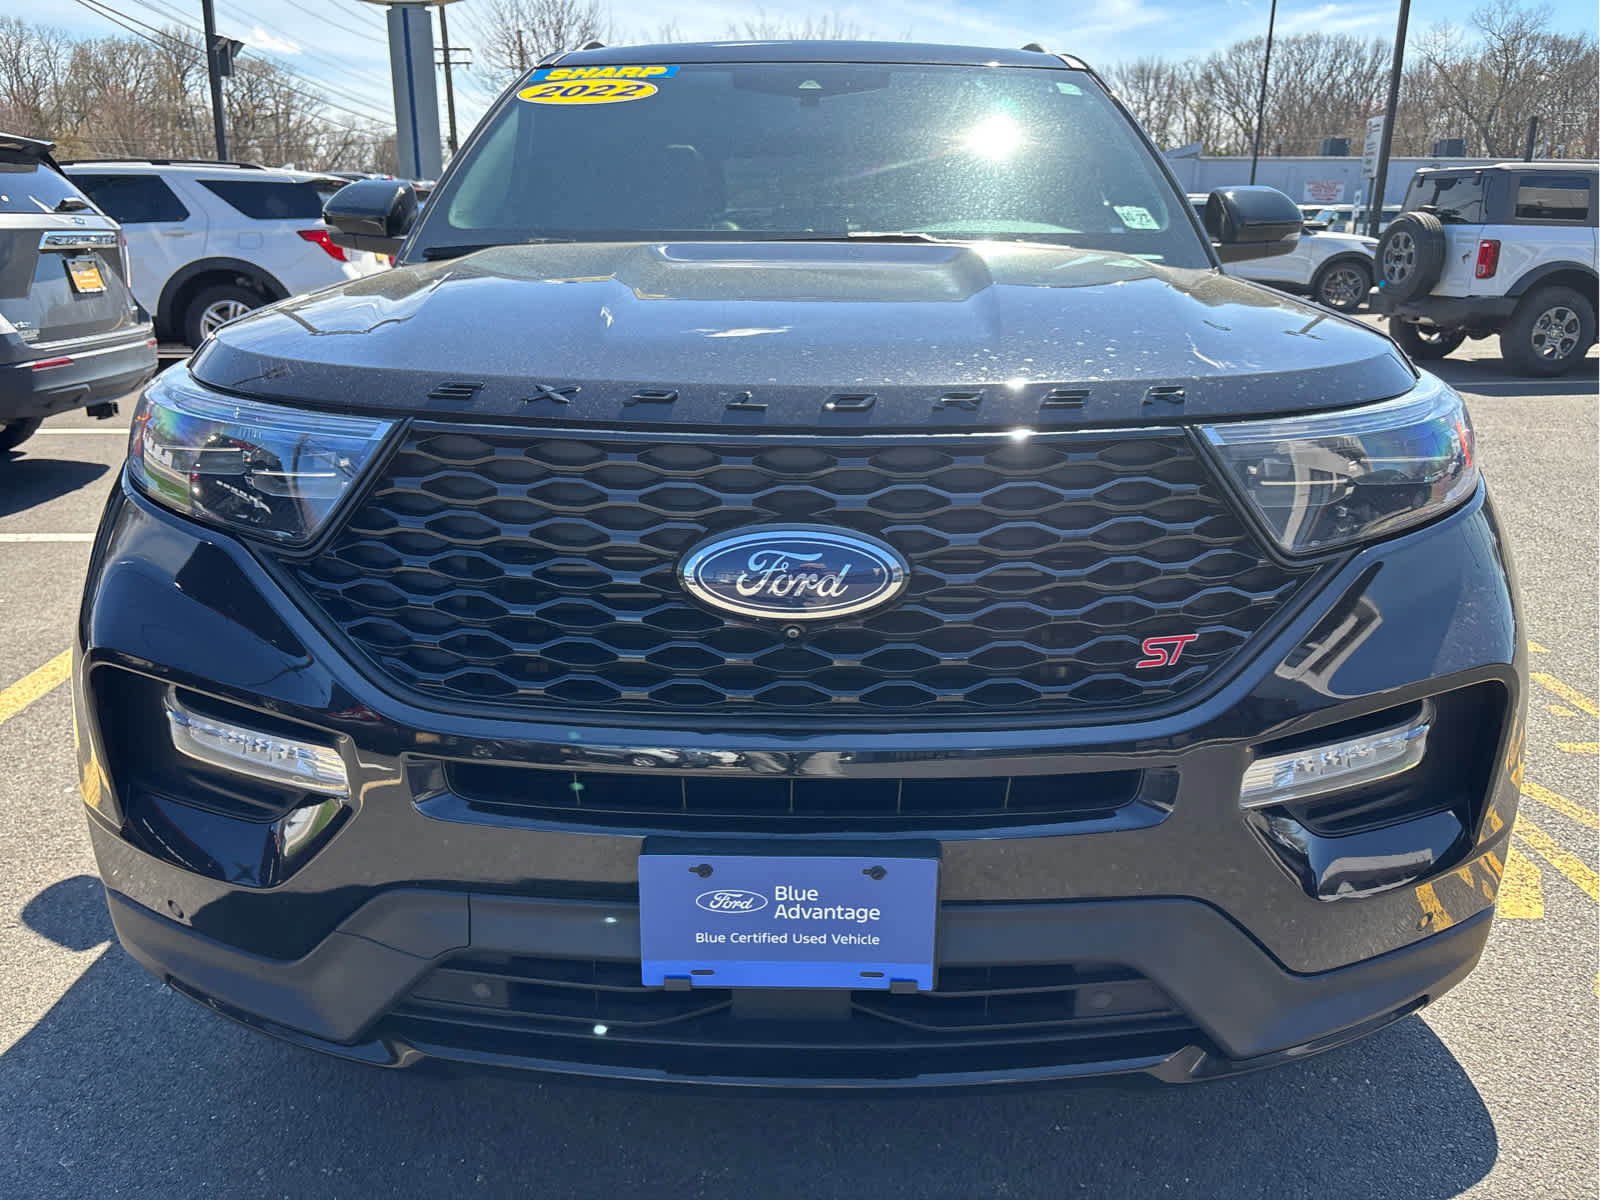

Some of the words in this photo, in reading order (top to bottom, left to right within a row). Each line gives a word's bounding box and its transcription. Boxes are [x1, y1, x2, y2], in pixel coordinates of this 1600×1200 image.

[544, 66, 667, 80] SHARP
[528, 84, 645, 98] 2022
[427, 381, 1187, 411] EXPLORER
[736, 550, 852, 597] Ford
[1136, 633, 1199, 668] ST
[709, 892, 754, 910] Ford
[774, 885, 819, 901] Blue
[774, 903, 881, 923] Advantage
[695, 932, 726, 944] Blue
[730, 932, 788, 944] Certified
[792, 933, 827, 945] Used
[831, 933, 880, 945] Vehicle
